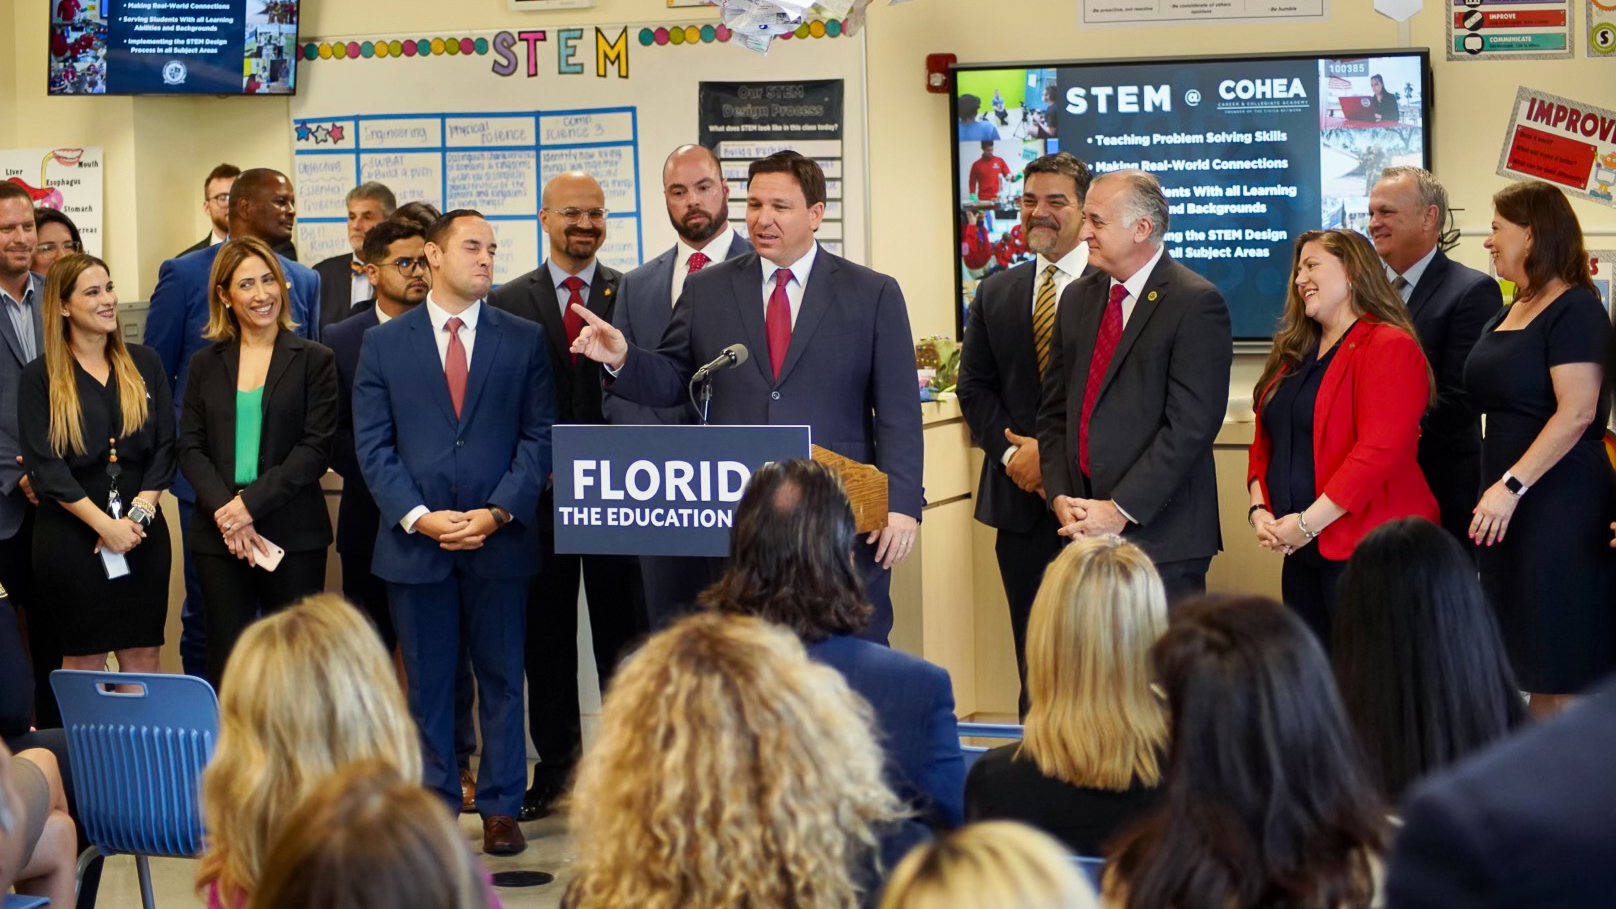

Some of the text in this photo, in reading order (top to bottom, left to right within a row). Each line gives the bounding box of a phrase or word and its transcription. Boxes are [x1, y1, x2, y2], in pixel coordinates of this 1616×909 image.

[1600, 30, 1608, 44] S
[492, 25, 629, 79] STEM
[1330, 64, 1365, 72] 100385
[738, 85, 805, 99] Our STEM
[1066, 77, 1307, 114] STEM @ COHEA
[722, 103, 824, 119] Design Process
[818, 123, 838, 131] today?
[365, 126, 428, 143] Engineering
[1095, 130, 1287, 146] Teaching Problem Solving Skills
[1141, 158, 1209, 171] Real-World
[1212, 157, 1288, 169] Connections
[46, 179, 81, 187] Esophagus
[1161, 184, 1297, 197] ents With all Learning
[1168, 202, 1267, 215] nd Backgrounds
[1185, 229, 1206, 240] the
[1208, 229, 1242, 240] STEM
[1245, 228, 1287, 241] Design
[1185, 246, 1232, 259] Subject
[1234, 246, 1269, 257] Areas
[573, 460, 775, 502] FLORID
[559, 506, 733, 528] THE EDUCATION
